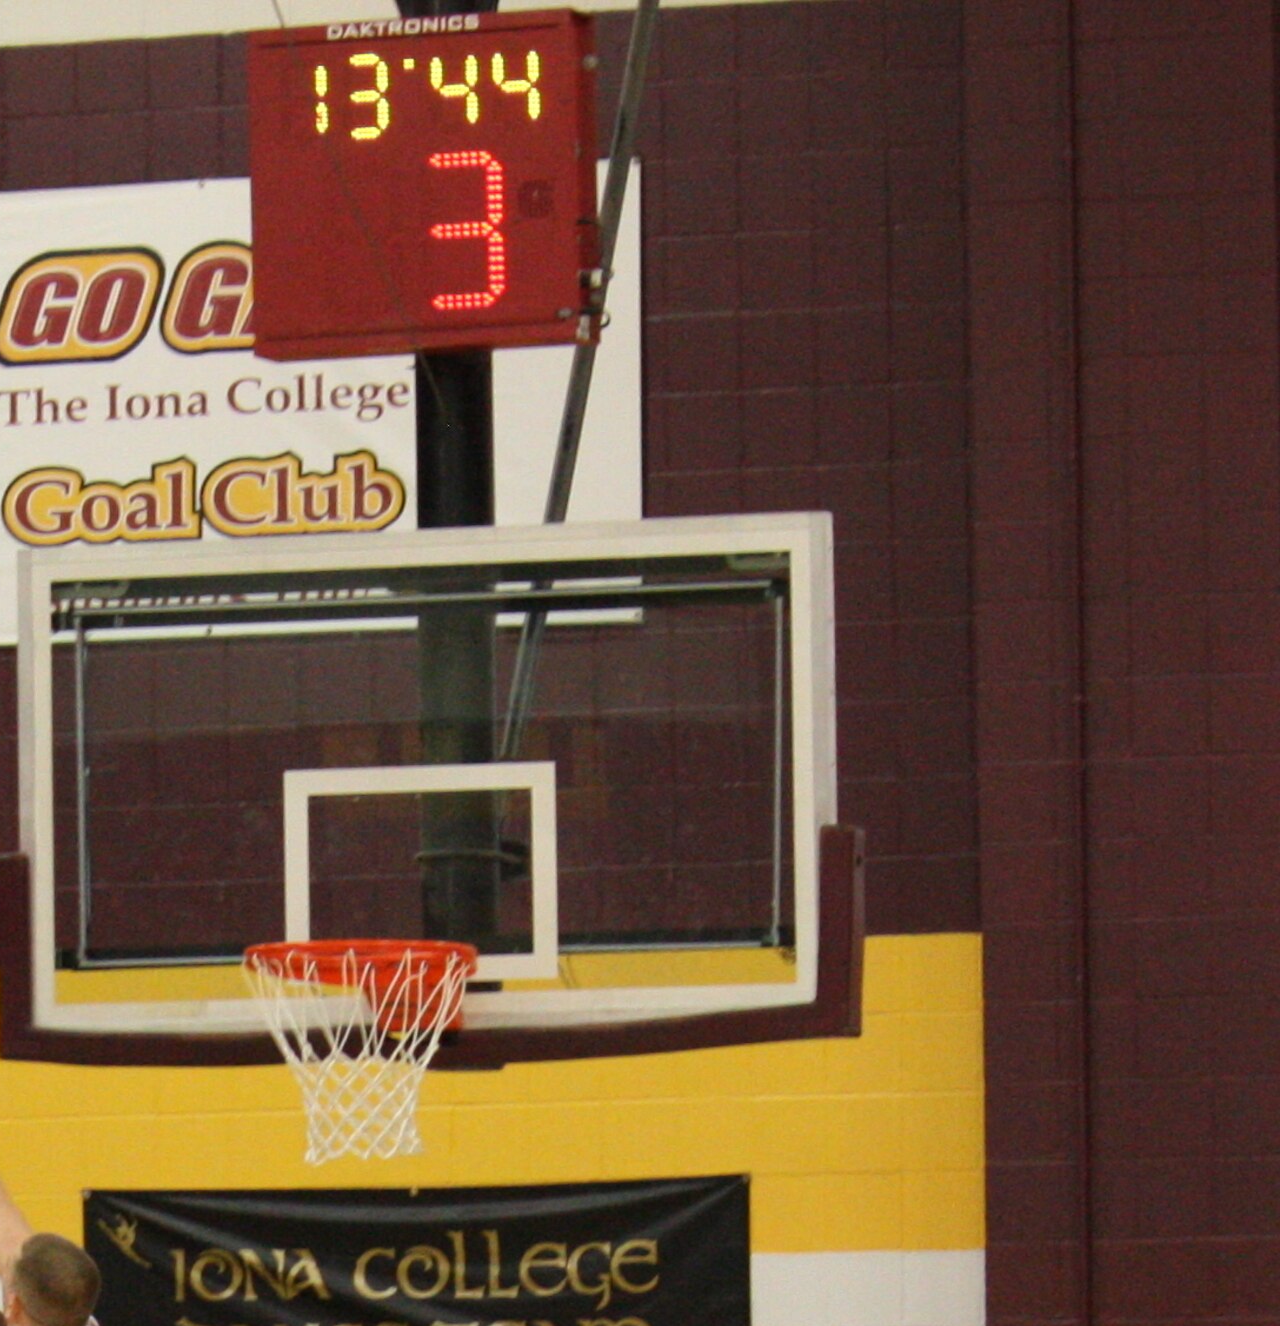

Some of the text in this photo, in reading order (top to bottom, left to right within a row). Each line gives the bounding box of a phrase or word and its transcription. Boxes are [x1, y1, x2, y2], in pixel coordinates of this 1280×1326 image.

[326, 14, 480, 41] DAKTRONICS
[428, 150, 505, 311] 3
[4, 253, 254, 352] GO G
[105, 384, 209, 422] Iona
[227, 373, 411, 422] College
[10, 460, 397, 538] Goal Club
[170, 1229, 660, 1311] IONA COLLEGE
